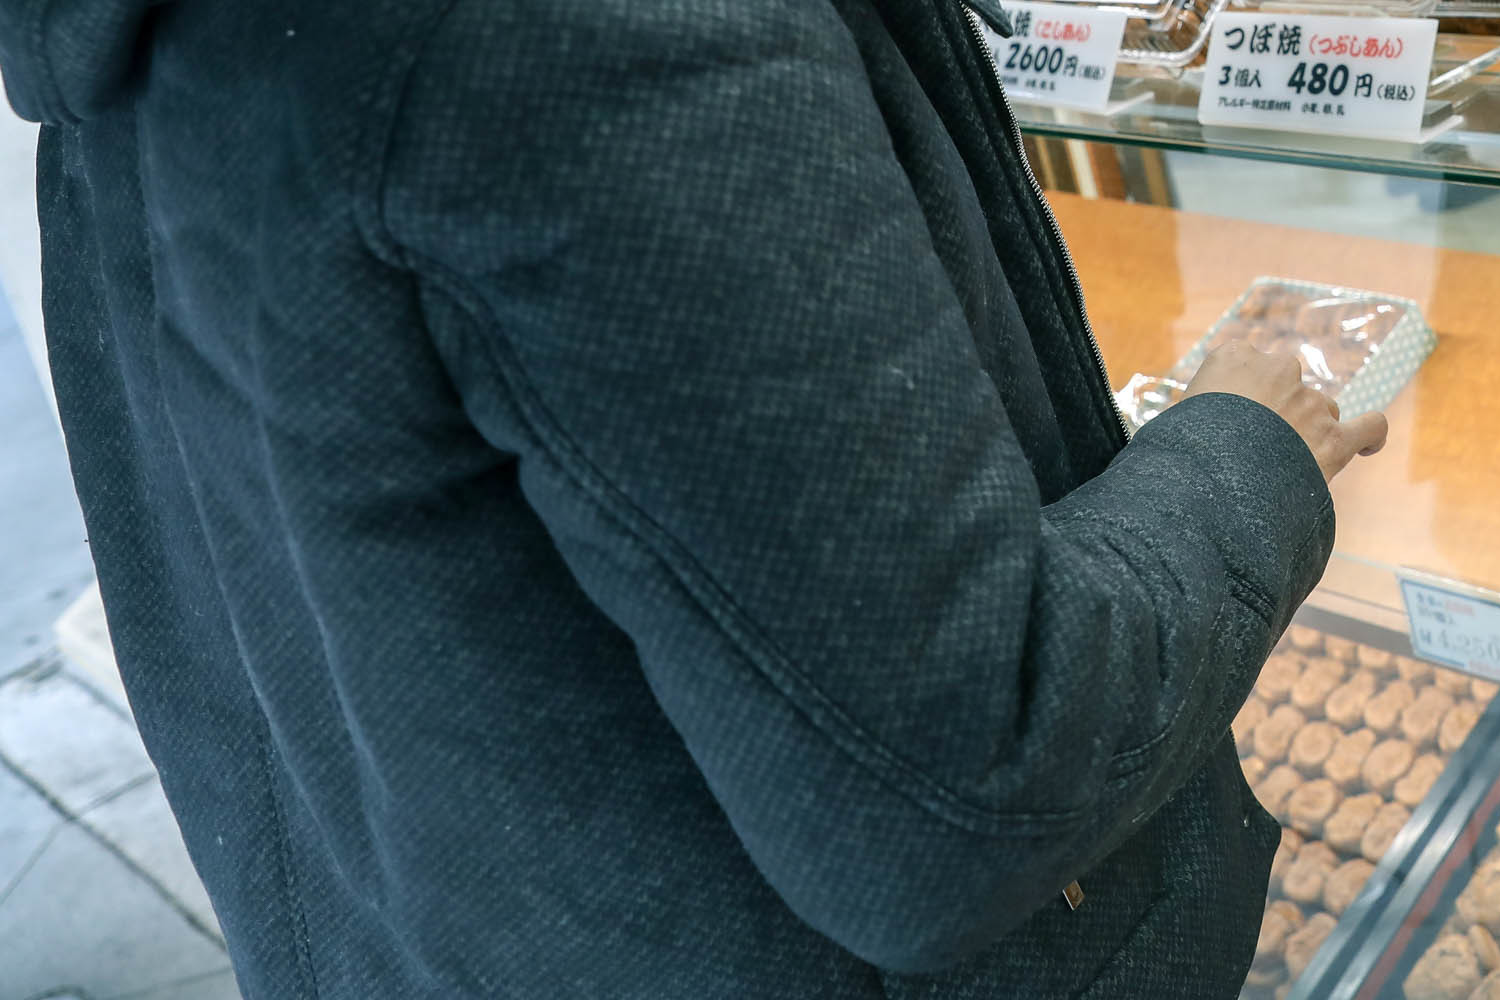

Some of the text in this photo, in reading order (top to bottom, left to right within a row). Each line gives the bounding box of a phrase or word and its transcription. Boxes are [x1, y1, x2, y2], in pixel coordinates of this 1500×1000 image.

[1224, 23, 1403, 59] つぼ焼 （つぶしあん）
[1218, 62, 1416, 101] 3個入 480円 （税込）
